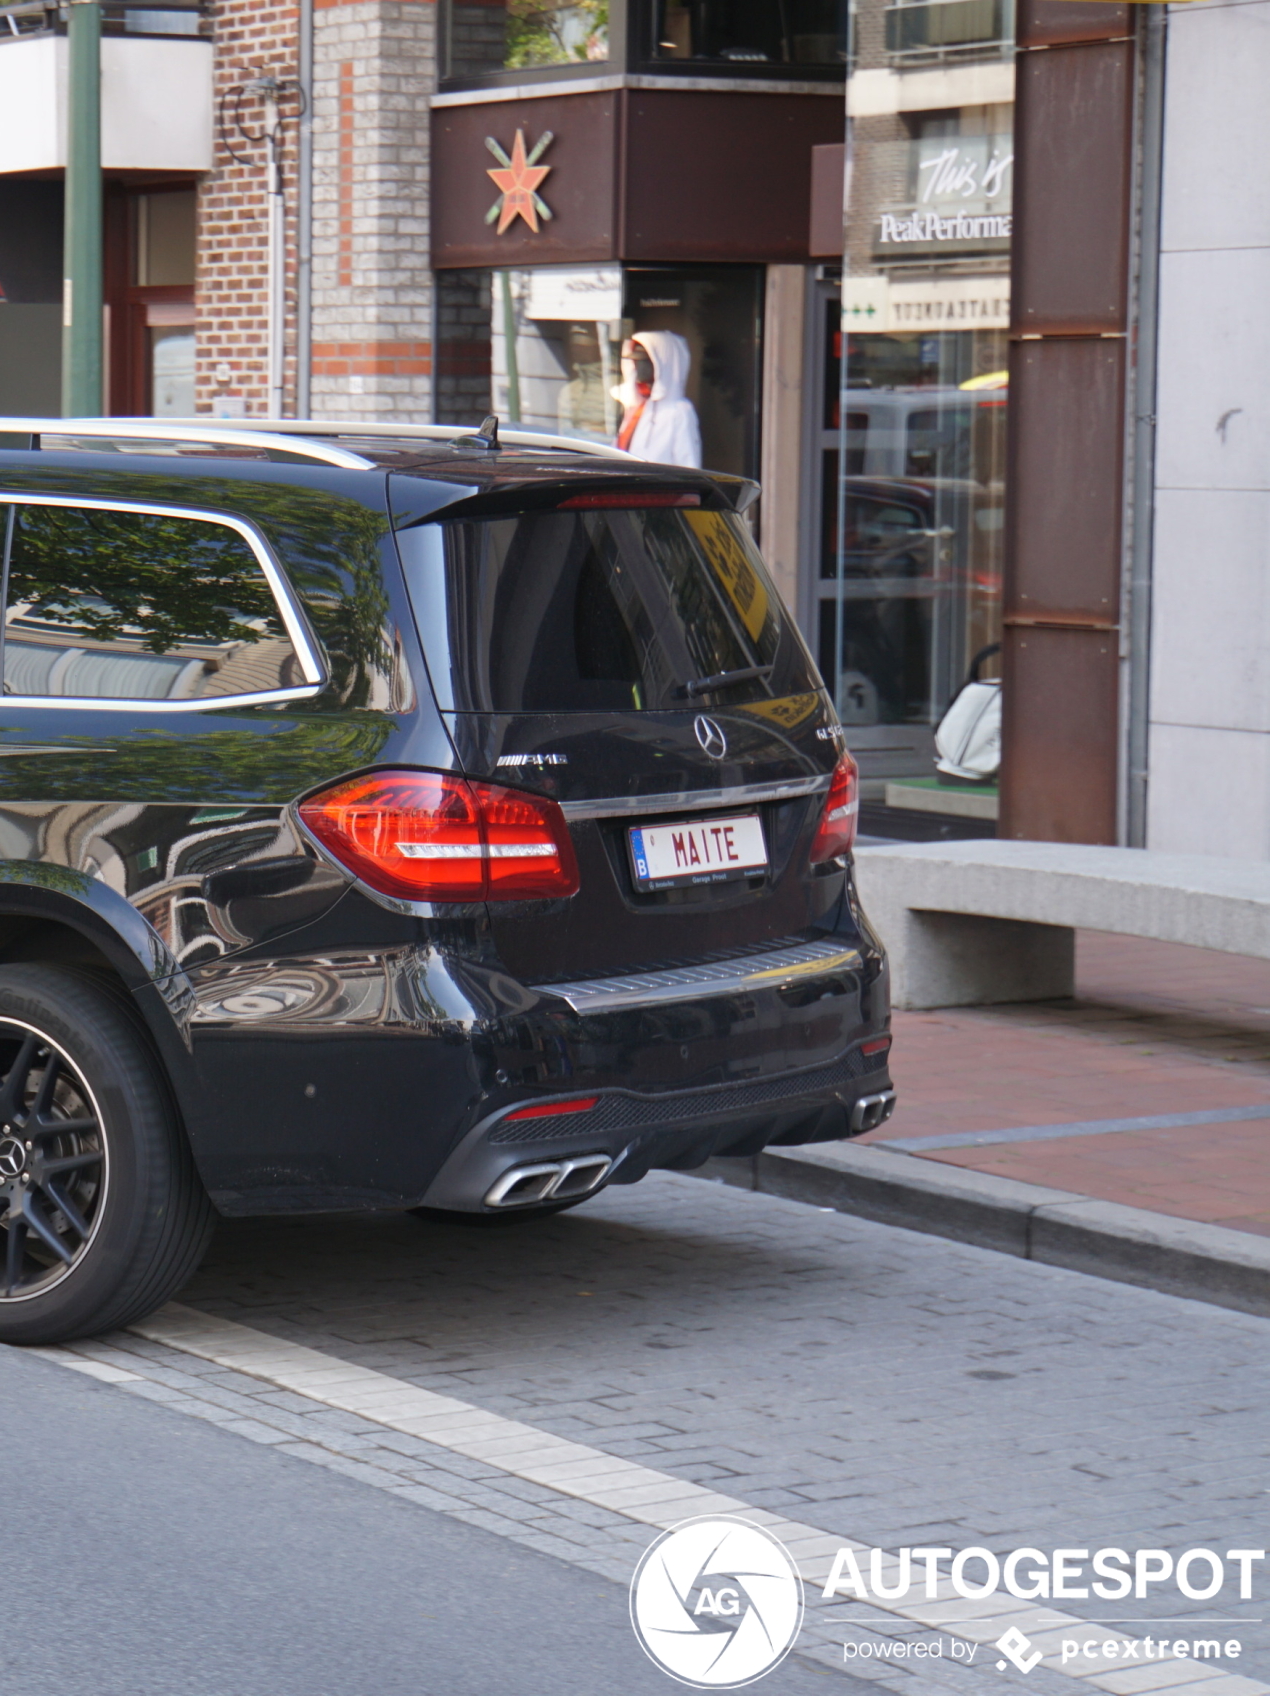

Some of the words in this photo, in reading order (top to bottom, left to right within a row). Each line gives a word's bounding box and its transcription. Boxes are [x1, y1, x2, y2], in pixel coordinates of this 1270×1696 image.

[920, 148, 977, 203] This
[982, 150, 1014, 198] is
[672, 827, 739, 868] MAITE
[637, 859, 648, 876] B
[692, 876, 711, 884] Garage
